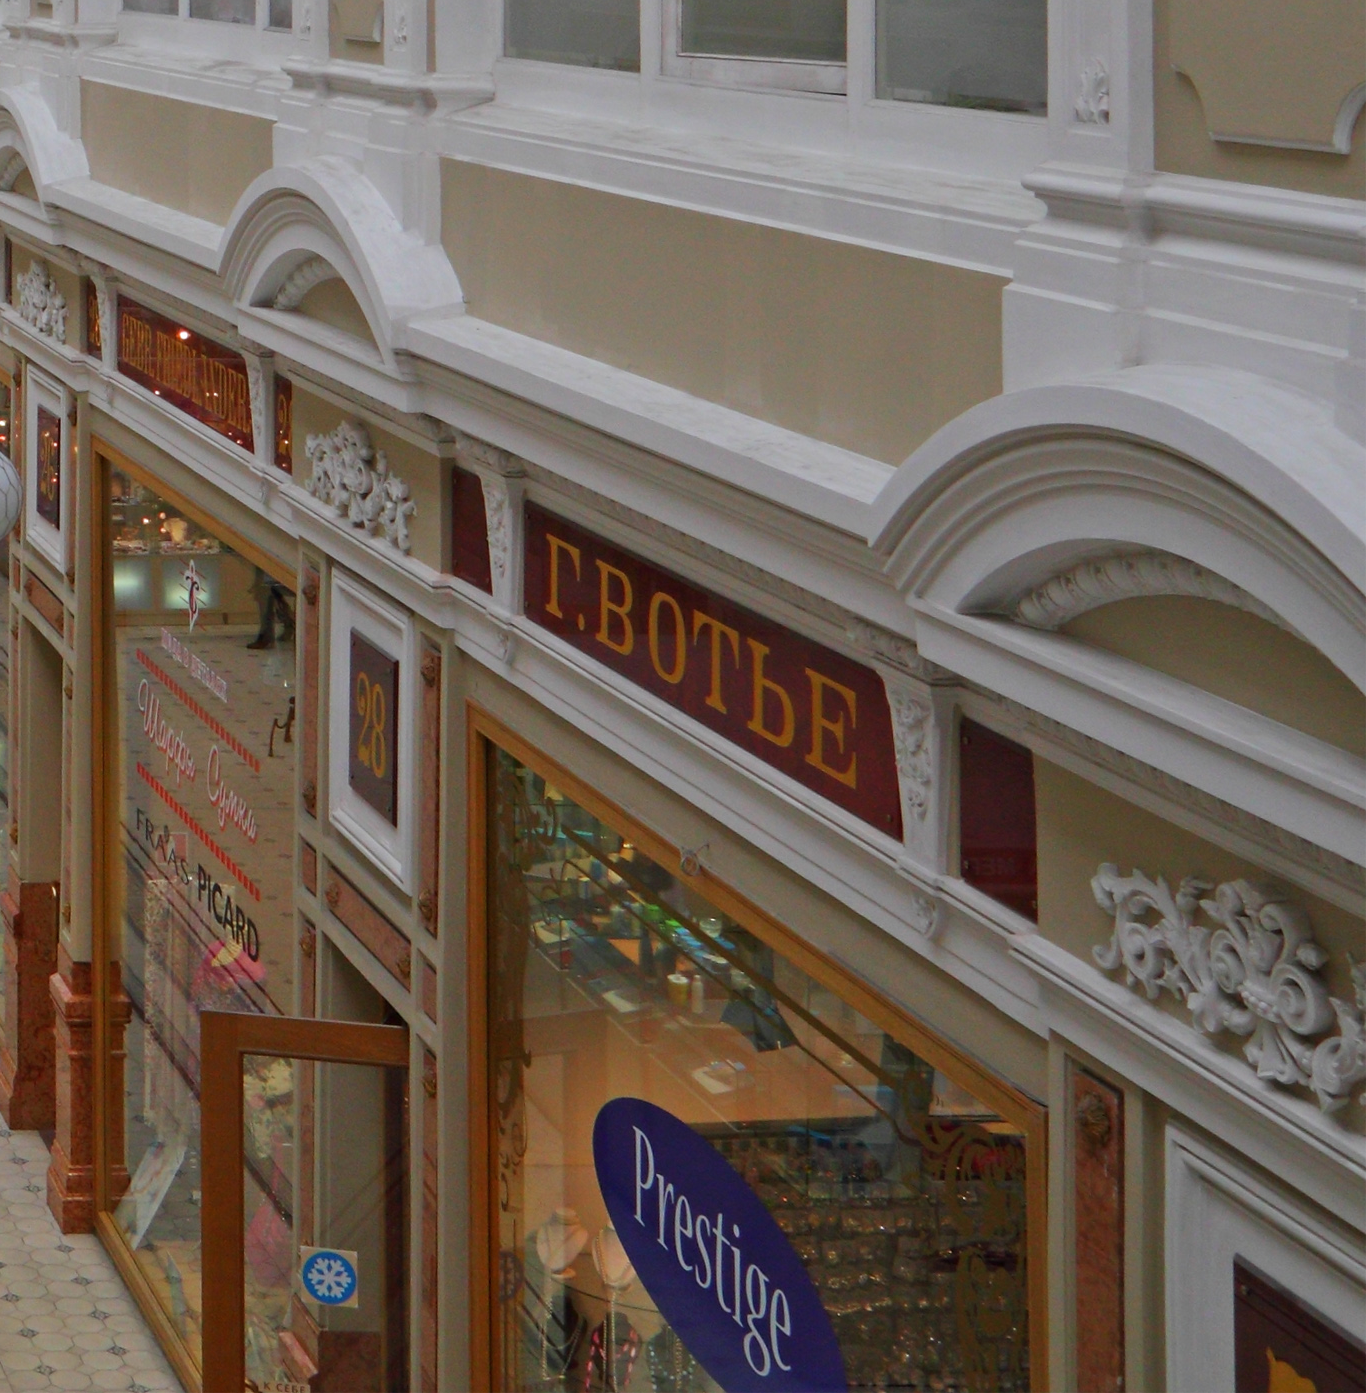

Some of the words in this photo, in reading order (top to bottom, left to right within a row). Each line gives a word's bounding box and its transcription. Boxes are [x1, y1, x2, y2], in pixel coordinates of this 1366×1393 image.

[357, 671, 387, 779] 28
[544, 533, 857, 790] Г.ВОТЬЕ
[198, 863, 259, 963] PICARD
[632, 1124, 792, 1377] Prestige
